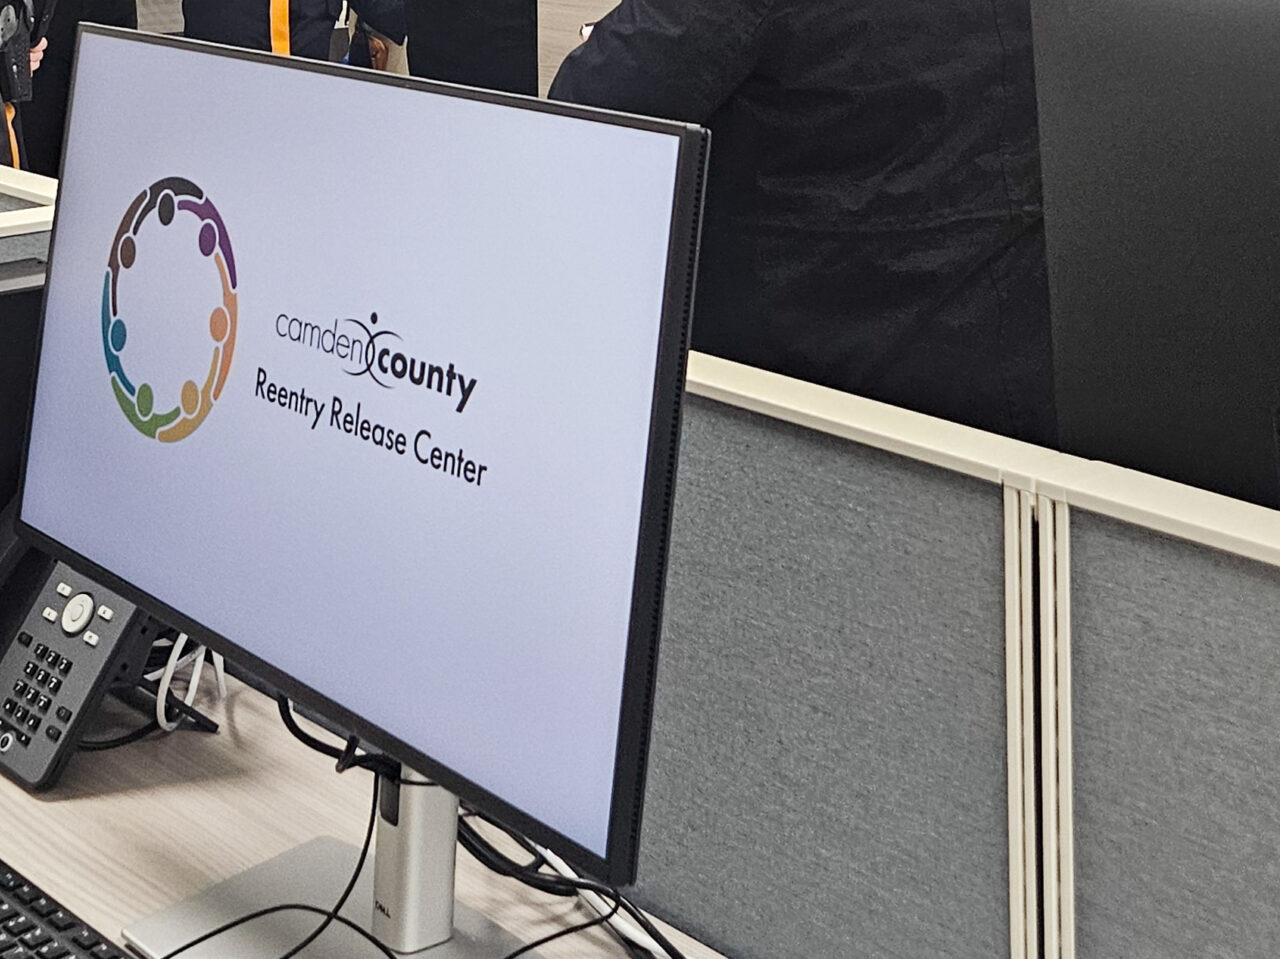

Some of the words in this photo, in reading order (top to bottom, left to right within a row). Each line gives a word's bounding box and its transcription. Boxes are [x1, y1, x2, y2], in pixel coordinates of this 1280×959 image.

[276, 313, 364, 365] camden
[377, 347, 478, 414] county
[255, 366, 326, 430] Reentry
[330, 396, 407, 455] Release
[414, 429, 488, 486] Center
